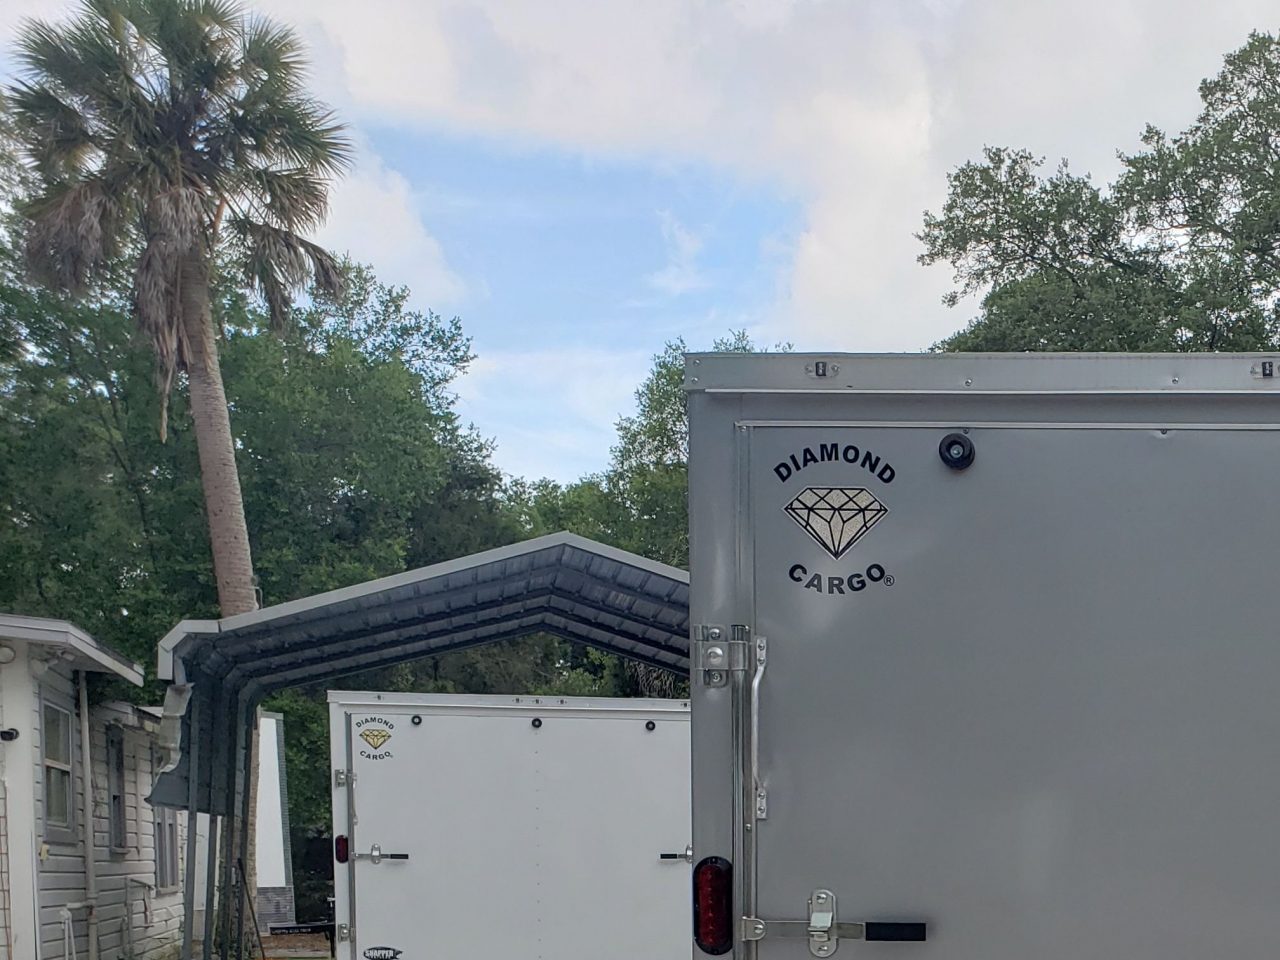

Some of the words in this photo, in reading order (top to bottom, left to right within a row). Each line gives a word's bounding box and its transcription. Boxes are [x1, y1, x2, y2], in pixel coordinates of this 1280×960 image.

[773, 443, 896, 484] DIAMOND
[355, 716, 395, 730] DIAMOND
[360, 750, 391, 760] CARGO
